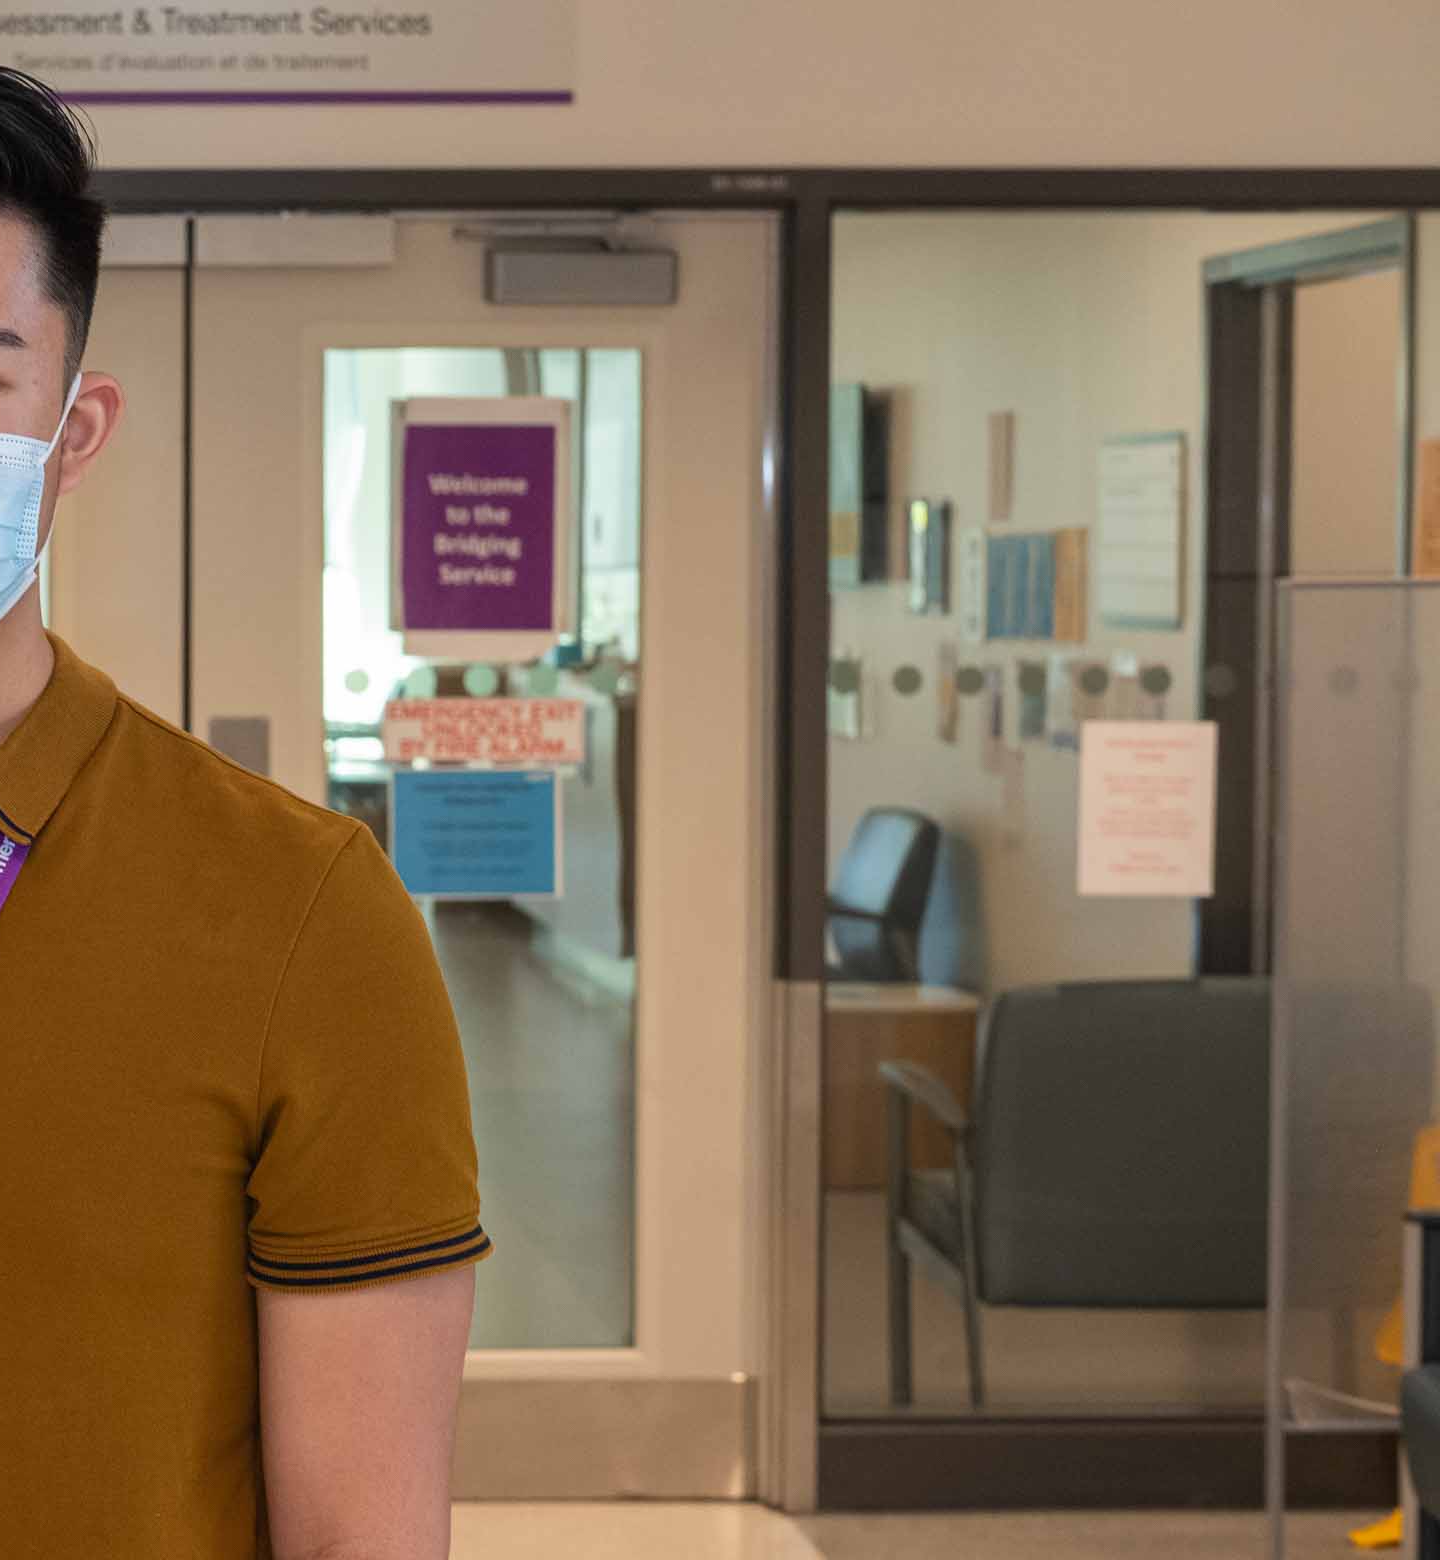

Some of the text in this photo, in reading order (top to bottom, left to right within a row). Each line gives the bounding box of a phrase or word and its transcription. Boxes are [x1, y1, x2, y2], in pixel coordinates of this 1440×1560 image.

[132, 8, 152, 35] &
[161, 7, 303, 36] Treatment
[310, 7, 432, 36] Services
[15, 53, 93, 71] Services
[271, 53, 369, 71] traitement
[427, 474, 527, 496] Welcome
[446, 503, 510, 526] to the
[433, 533, 521, 560] Bridging
[439, 564, 517, 586] Service
